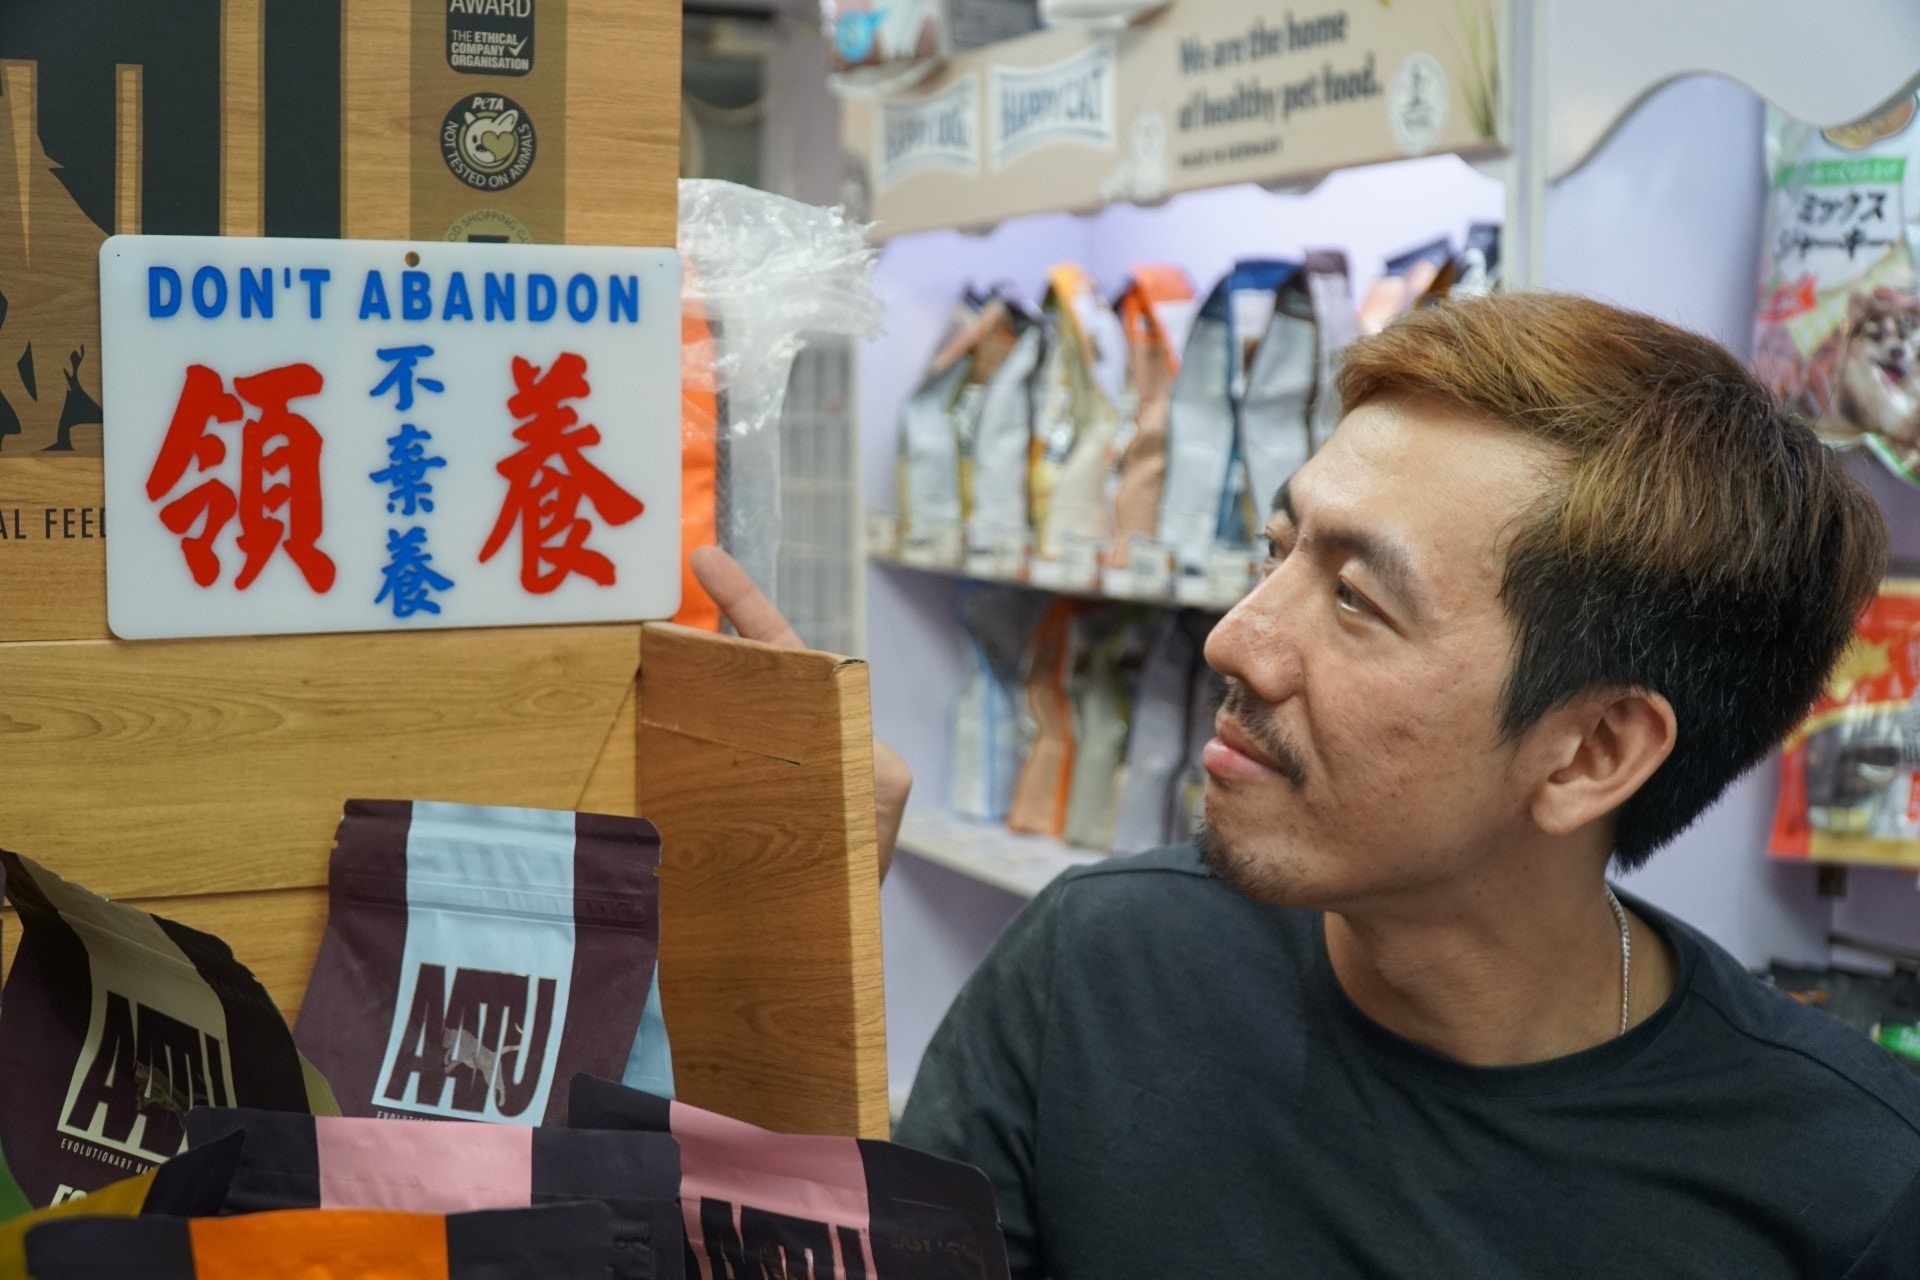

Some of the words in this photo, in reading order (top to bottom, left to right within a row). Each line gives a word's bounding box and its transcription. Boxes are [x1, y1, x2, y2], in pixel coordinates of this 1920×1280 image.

[449, 0, 531, 17] AWARD
[452, 30, 472, 41] THE
[474, 31, 519, 45] ETHICAL
[1285, 10, 1347, 50] home
[451, 42, 505, 56] COMPANY
[451, 54, 529, 70] ORGANISATION
[444, 120, 460, 148] NOT
[511, 122, 534, 180] ANIMALS
[447, 150, 487, 187] TESTED
[489, 174, 510, 188] ON
[462, 211, 518, 230] SHOPPING
[148, 265, 331, 320] DON'T
[359, 270, 639, 324] ABANDON
[146, 362, 336, 594] 領
[478, 351, 645, 594] 養
[60, 1138, 132, 1170] EVOLUTIONARY
